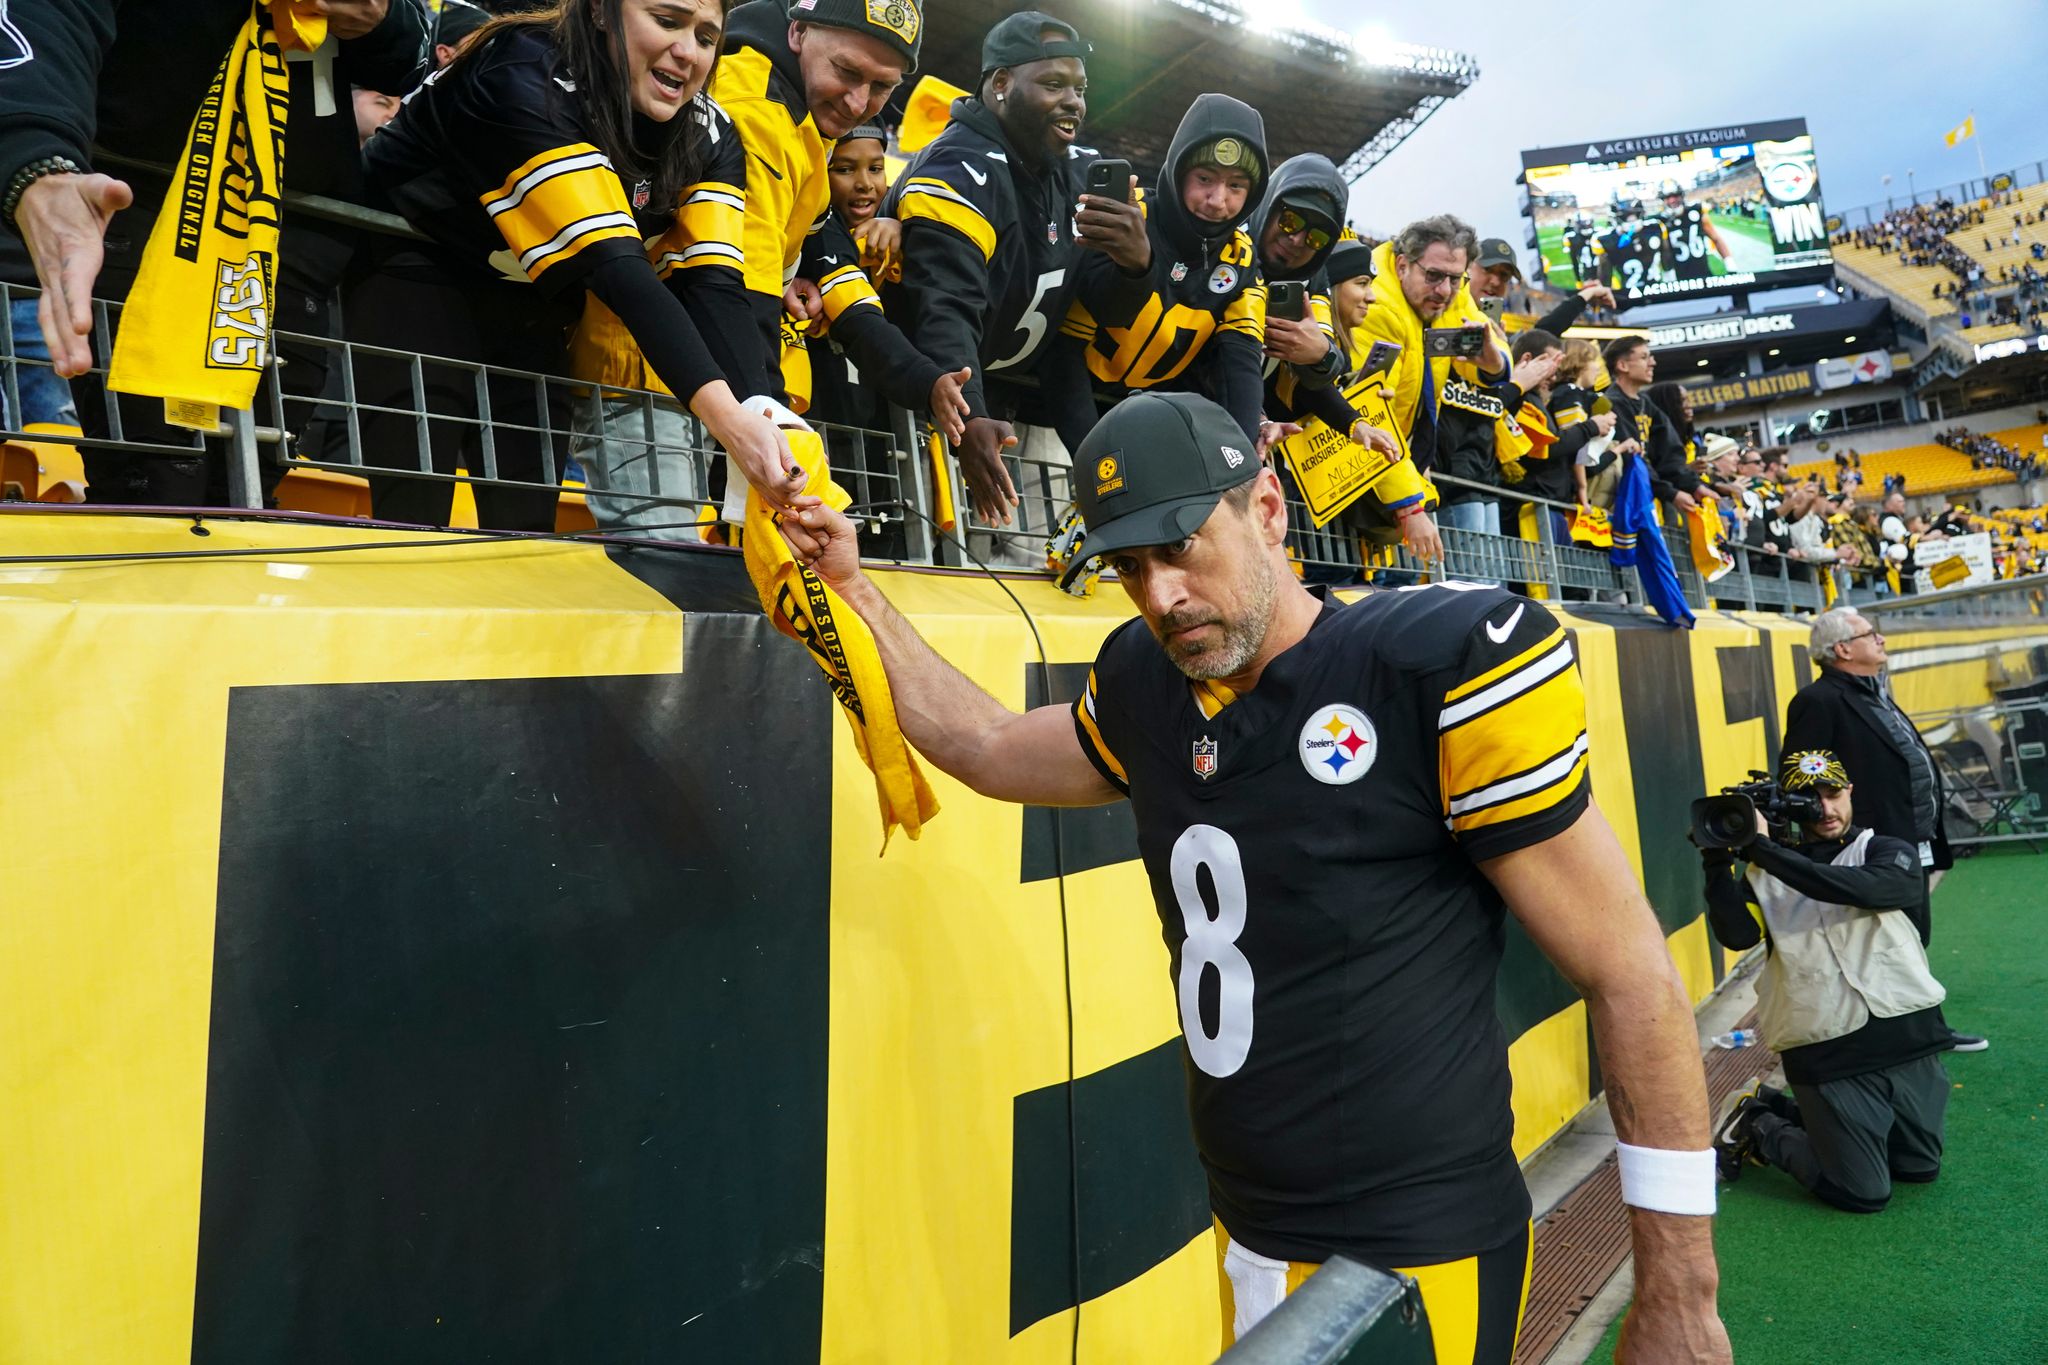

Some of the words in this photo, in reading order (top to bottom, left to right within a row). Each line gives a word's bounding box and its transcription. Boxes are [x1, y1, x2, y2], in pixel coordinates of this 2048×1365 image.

[1605, 137, 1680, 156] ACRISURE
[1684, 128, 1747, 146] STADIUM
[181, 153, 210, 249] ORIGINAL
[1769, 202, 1825, 244] WIN
[1669, 224, 1705, 262] 56
[1643, 278, 1704, 297] ACRISURE
[1706, 272, 1756, 288] STADIUM
[211, 256, 266, 368] 1975
[984, 268, 1066, 371] 5
[1685, 320, 1741, 342] LIGHT
[1744, 313, 1795, 335] DECK
[1444, 381, 1502, 414] Steelers
[1687, 383, 1745, 408] EELERS
[1747, 370, 1811, 397] NATION
[1301, 443, 1338, 473] ACRISURE
[1370, 410, 1386, 428] ROM
[1313, 427, 1338, 449] TRAV
[1306, 739, 1335, 749] Steelers
[1195, 755, 1213, 772] NFL
[1169, 823, 1255, 1079] 8
